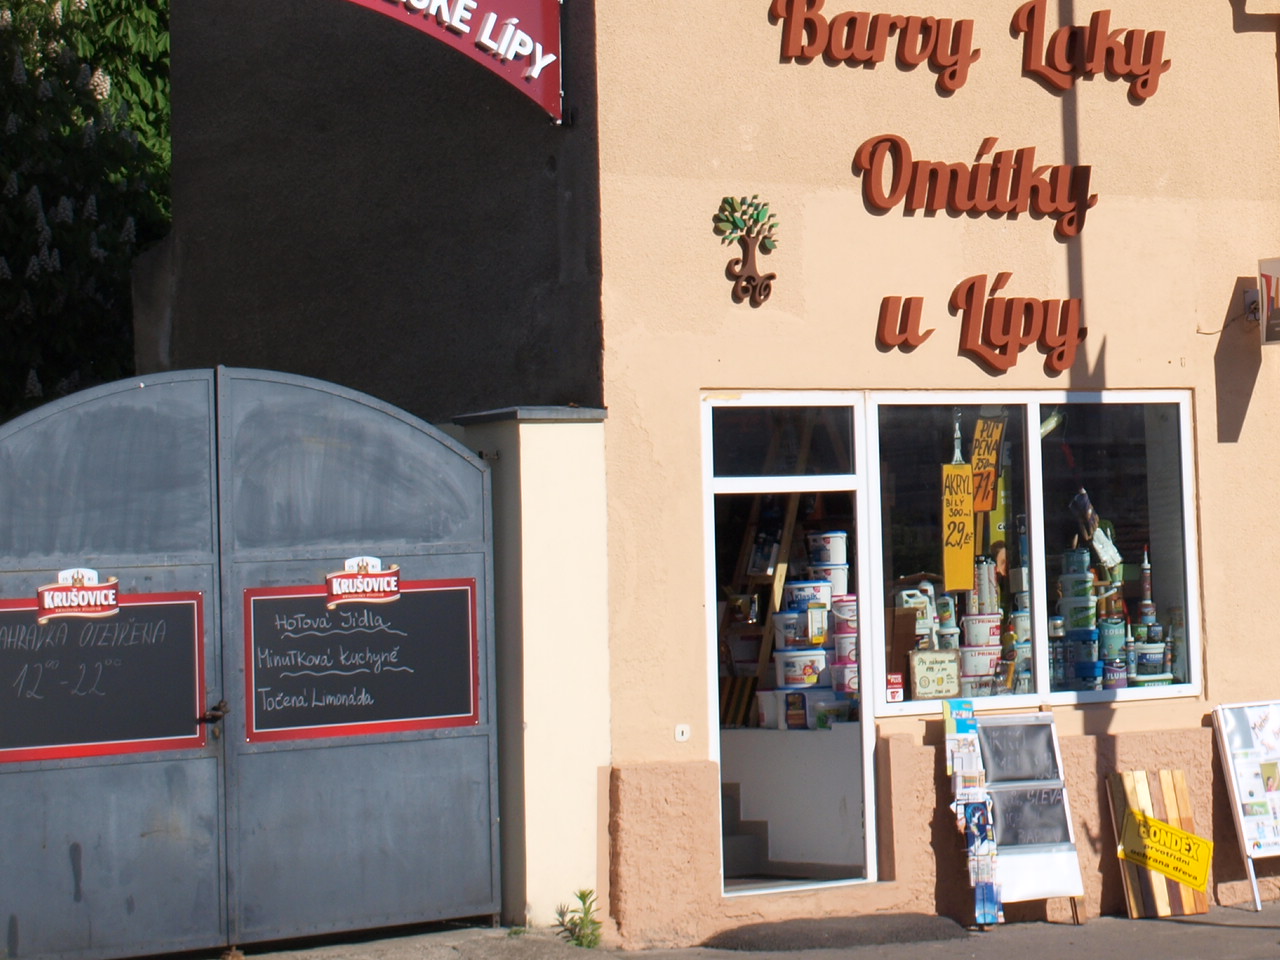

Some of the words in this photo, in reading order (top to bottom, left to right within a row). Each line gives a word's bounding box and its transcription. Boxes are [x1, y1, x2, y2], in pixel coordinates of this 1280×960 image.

[476, 12, 558, 80] LÍPY
[852, 134, 1098, 237] Omítky
[877, 296, 935, 350] u
[949, 272, 1088, 372] Lípy
[944, 474, 972, 496] AKRYL
[43, 588, 117, 609] KRUŠOVICE
[331, 576, 398, 596] KRUŠOVICE
[257, 687, 308, 712] Točená
[311, 687, 375, 708] Limonáda
[1138, 821, 1201, 862] BONDEX
[1172, 865, 1198, 881] dřeva
